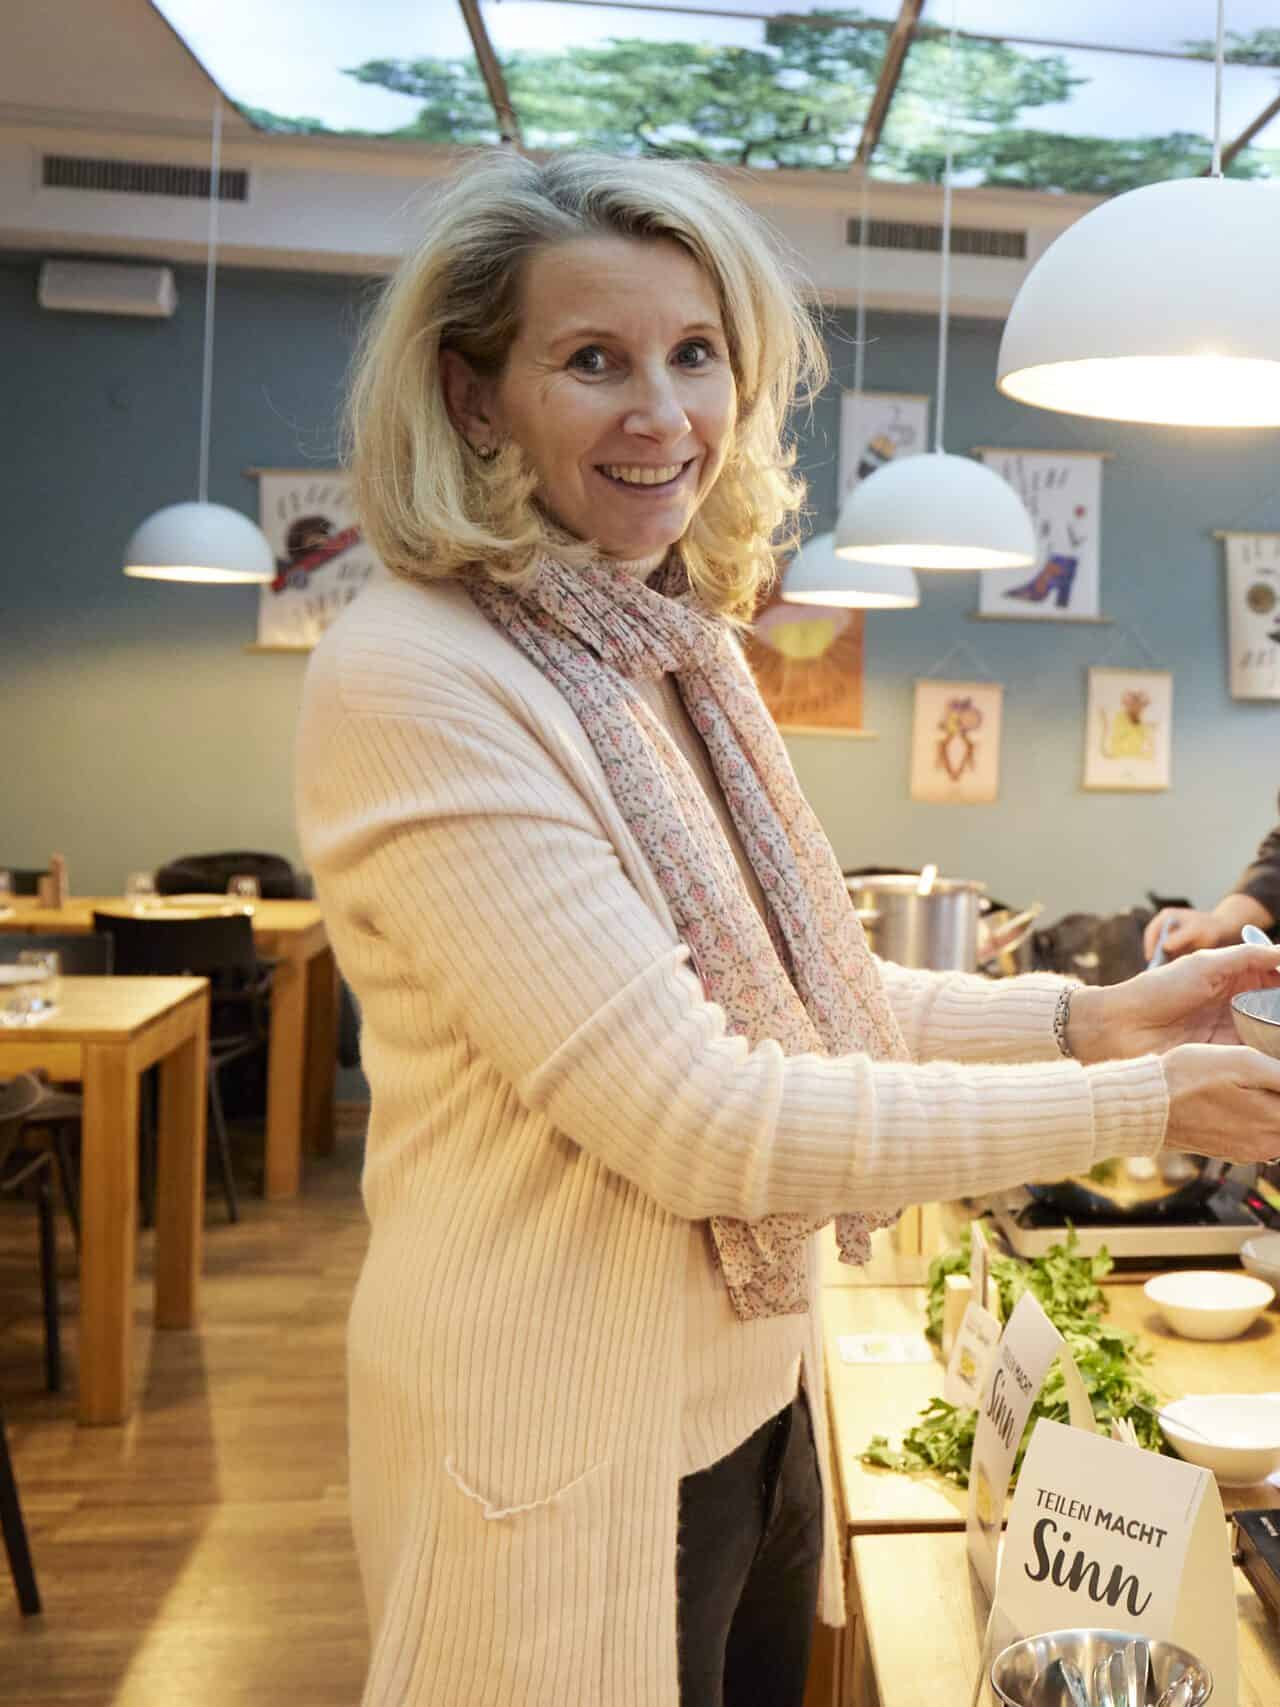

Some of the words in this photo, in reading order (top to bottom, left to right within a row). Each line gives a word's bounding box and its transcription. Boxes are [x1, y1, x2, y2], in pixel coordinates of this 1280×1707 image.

[1036, 1488, 1092, 1523] TEILEN
[1094, 1508, 1168, 1548] MACHT
[1024, 1518, 1152, 1616] Sinn
